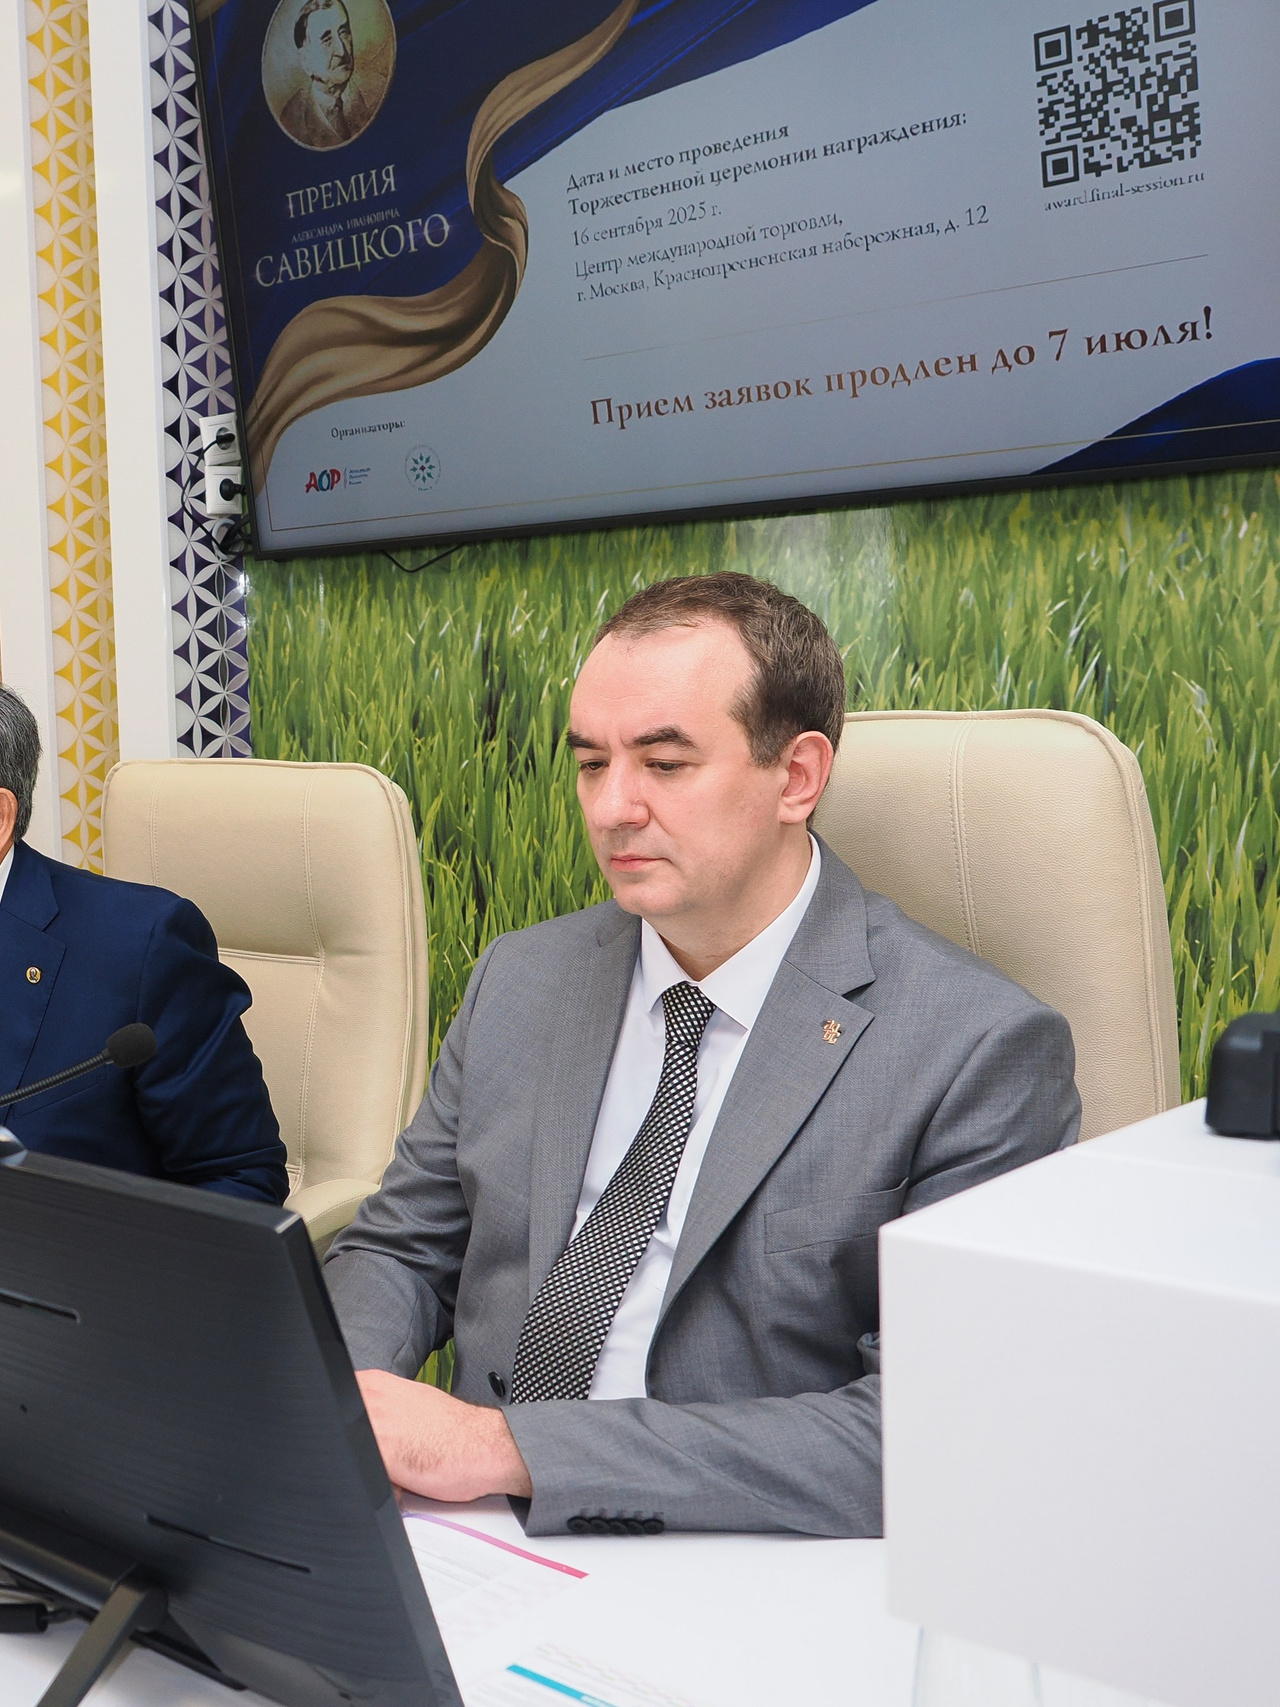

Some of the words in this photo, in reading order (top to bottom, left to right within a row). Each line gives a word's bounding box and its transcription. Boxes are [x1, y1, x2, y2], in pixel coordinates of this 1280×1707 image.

[286, 164, 397, 218] ПРЕМИЯ
[566, 170, 605, 193] Дата
[608, 167, 620, 179] и
[623, 153, 675, 178] место
[679, 125, 790, 167] проведения
[568, 170, 705, 217] Торжественной
[710, 147, 818, 187] церемонии
[823, 111, 968, 158] награждения:
[255, 213, 451, 288] САВИЦКОГО
[291, 222, 344, 244] АЛЕКСАНДРА
[346, 208, 400, 230] ИВАНОВИЧА
[572, 229, 590, 247] 16
[593, 213, 664, 243] сентября
[667, 201, 708, 227] 2025
[710, 203, 723, 217] г.
[575, 258, 623, 281] Центр
[627, 225, 756, 267] международной
[760, 212, 844, 243] торговли,
[577, 290, 587, 302] г.
[589, 277, 649, 300] Москва,
[653, 244, 818, 288] Краснопресненская
[822, 220, 941, 256] набережная,
[943, 219, 960, 235] д.
[964, 204, 990, 227] 12
[591, 391, 695, 430] Прием
[703, 377, 813, 411] заявок
[824, 353, 979, 399] продлен
[990, 346, 1036, 375] до
[1048, 328, 1069, 362] 7
[1084, 304, 1214, 356] июля!
[331, 420, 406, 440] Организаторы:
